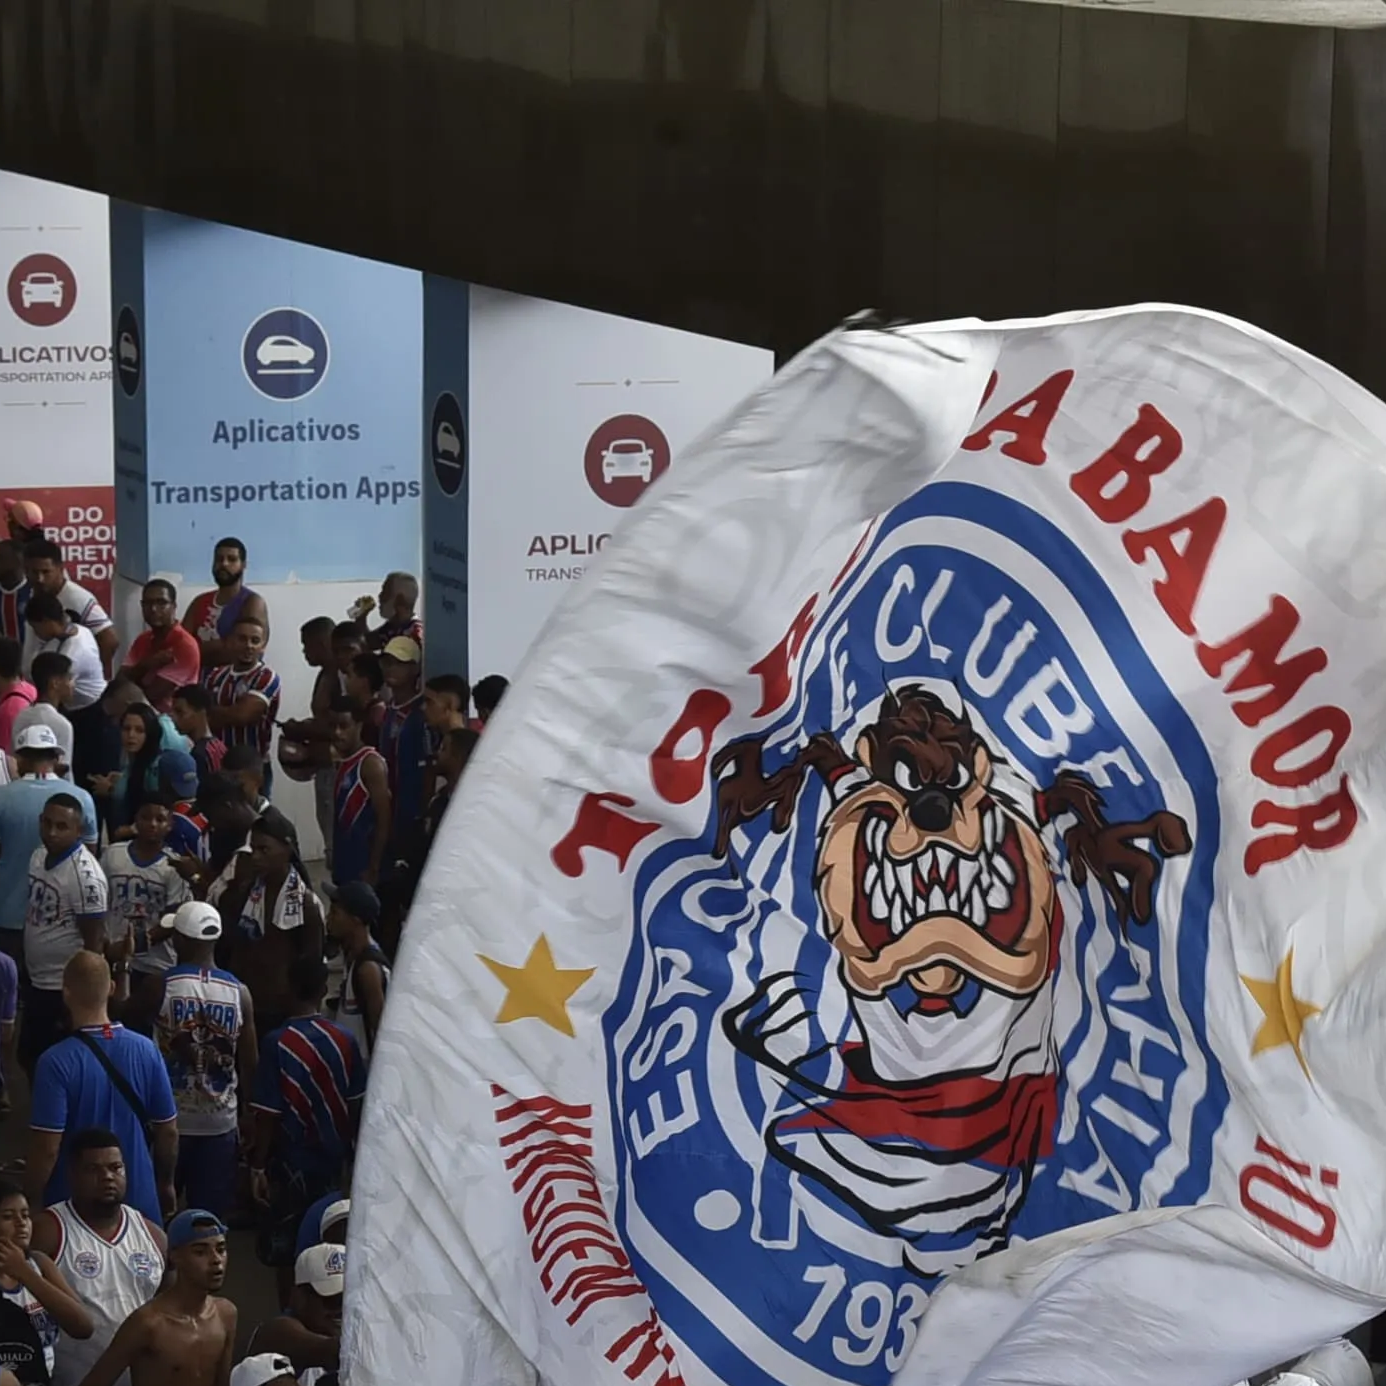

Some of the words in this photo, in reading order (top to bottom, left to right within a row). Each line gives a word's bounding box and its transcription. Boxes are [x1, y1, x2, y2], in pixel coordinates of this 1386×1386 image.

[212, 418, 361, 449] Aplicativos
[68, 506, 103, 523] DO
[150, 477, 348, 510] Transportation
[355, 475, 422, 505] Apps
[1069, 402, 1359, 878] BAMOR
[874, 562, 1145, 792] CLUBE
[1056, 935, 1180, 1213] AHIA
[792, 1263, 929, 1374] 193
